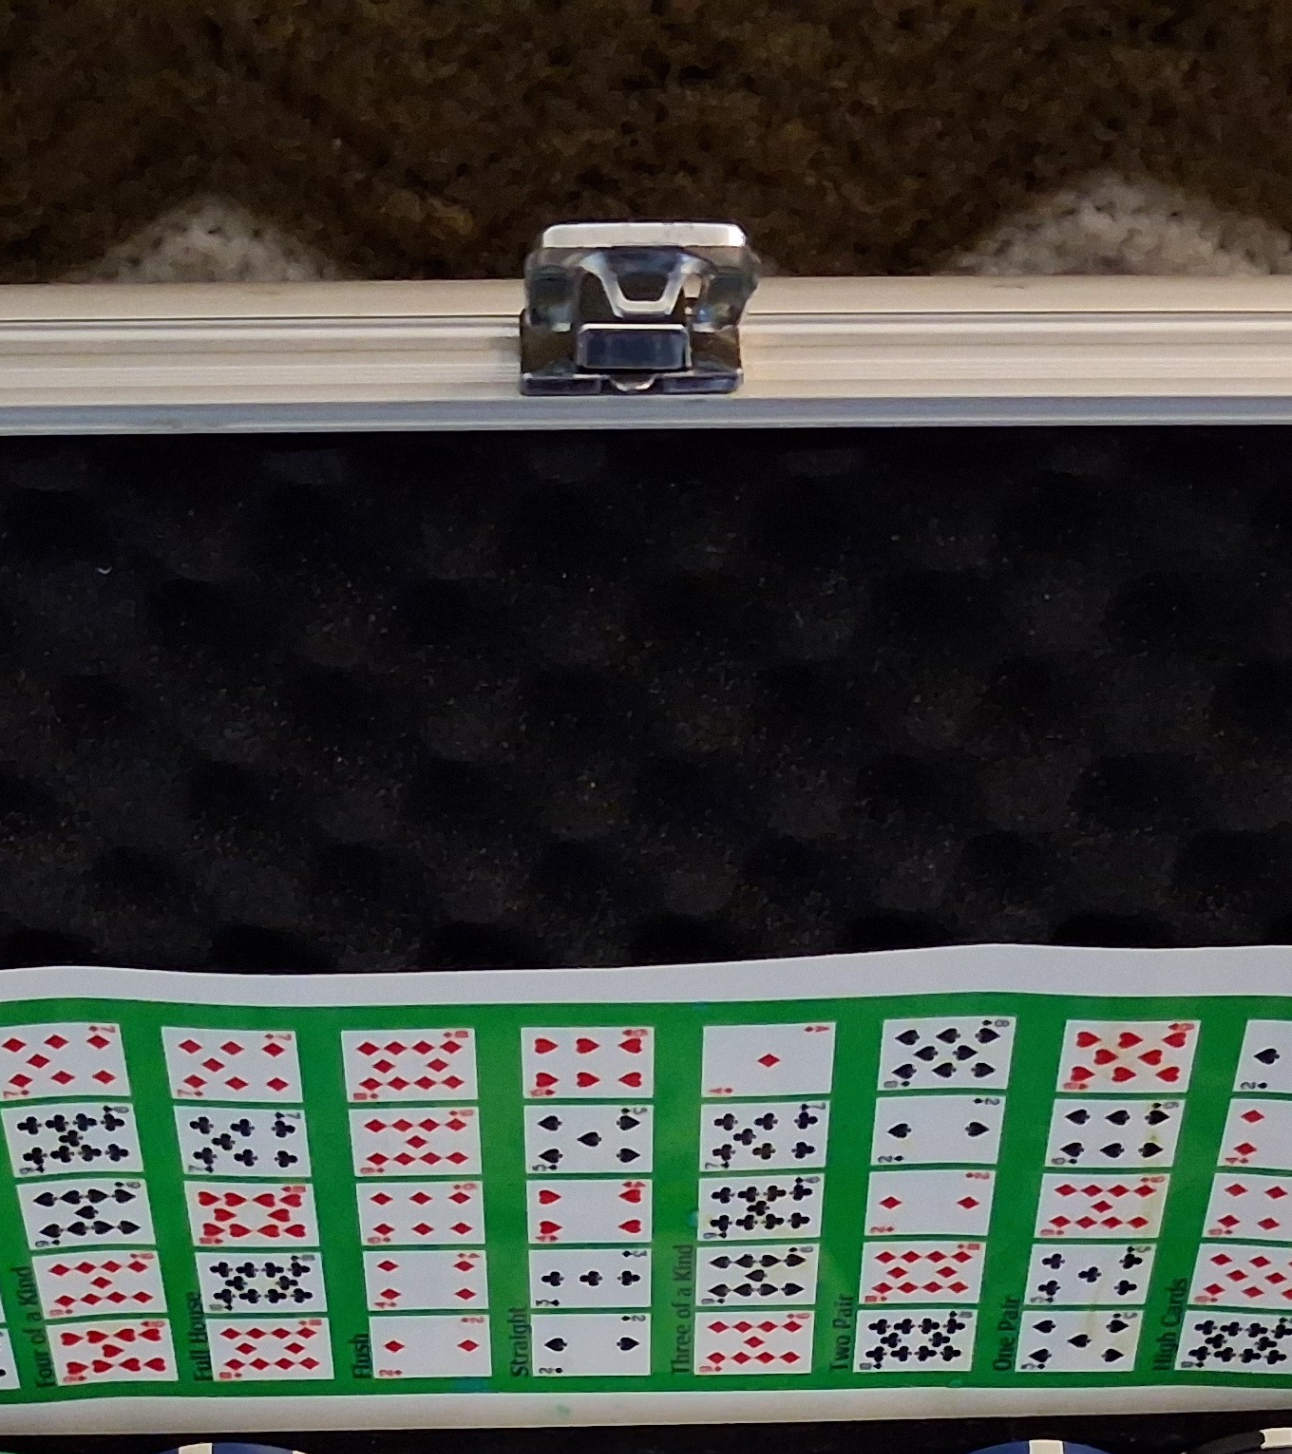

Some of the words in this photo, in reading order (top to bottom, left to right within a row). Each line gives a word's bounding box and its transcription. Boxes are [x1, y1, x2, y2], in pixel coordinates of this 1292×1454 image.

[673, 1245, 693, 1281] Kind
[11, 1266, 38, 1306] Kind
[1161, 1277, 1189, 1327] Cards
[186, 1291, 207, 1344] House
[672, 1303, 691, 1319] of
[832, 1293, 853, 1330] Pair
[997, 1297, 1020, 1331] Pair
[349, 1333, 372, 1379] Flush
[508, 1307, 532, 1378] Straight
[671, 1325, 691, 1374] Three
[830, 1335, 850, 1371] Two
[993, 1337, 1017, 1371] One
[34, 1351, 58, 1388] Four
[188, 1347, 213, 1381] Full
